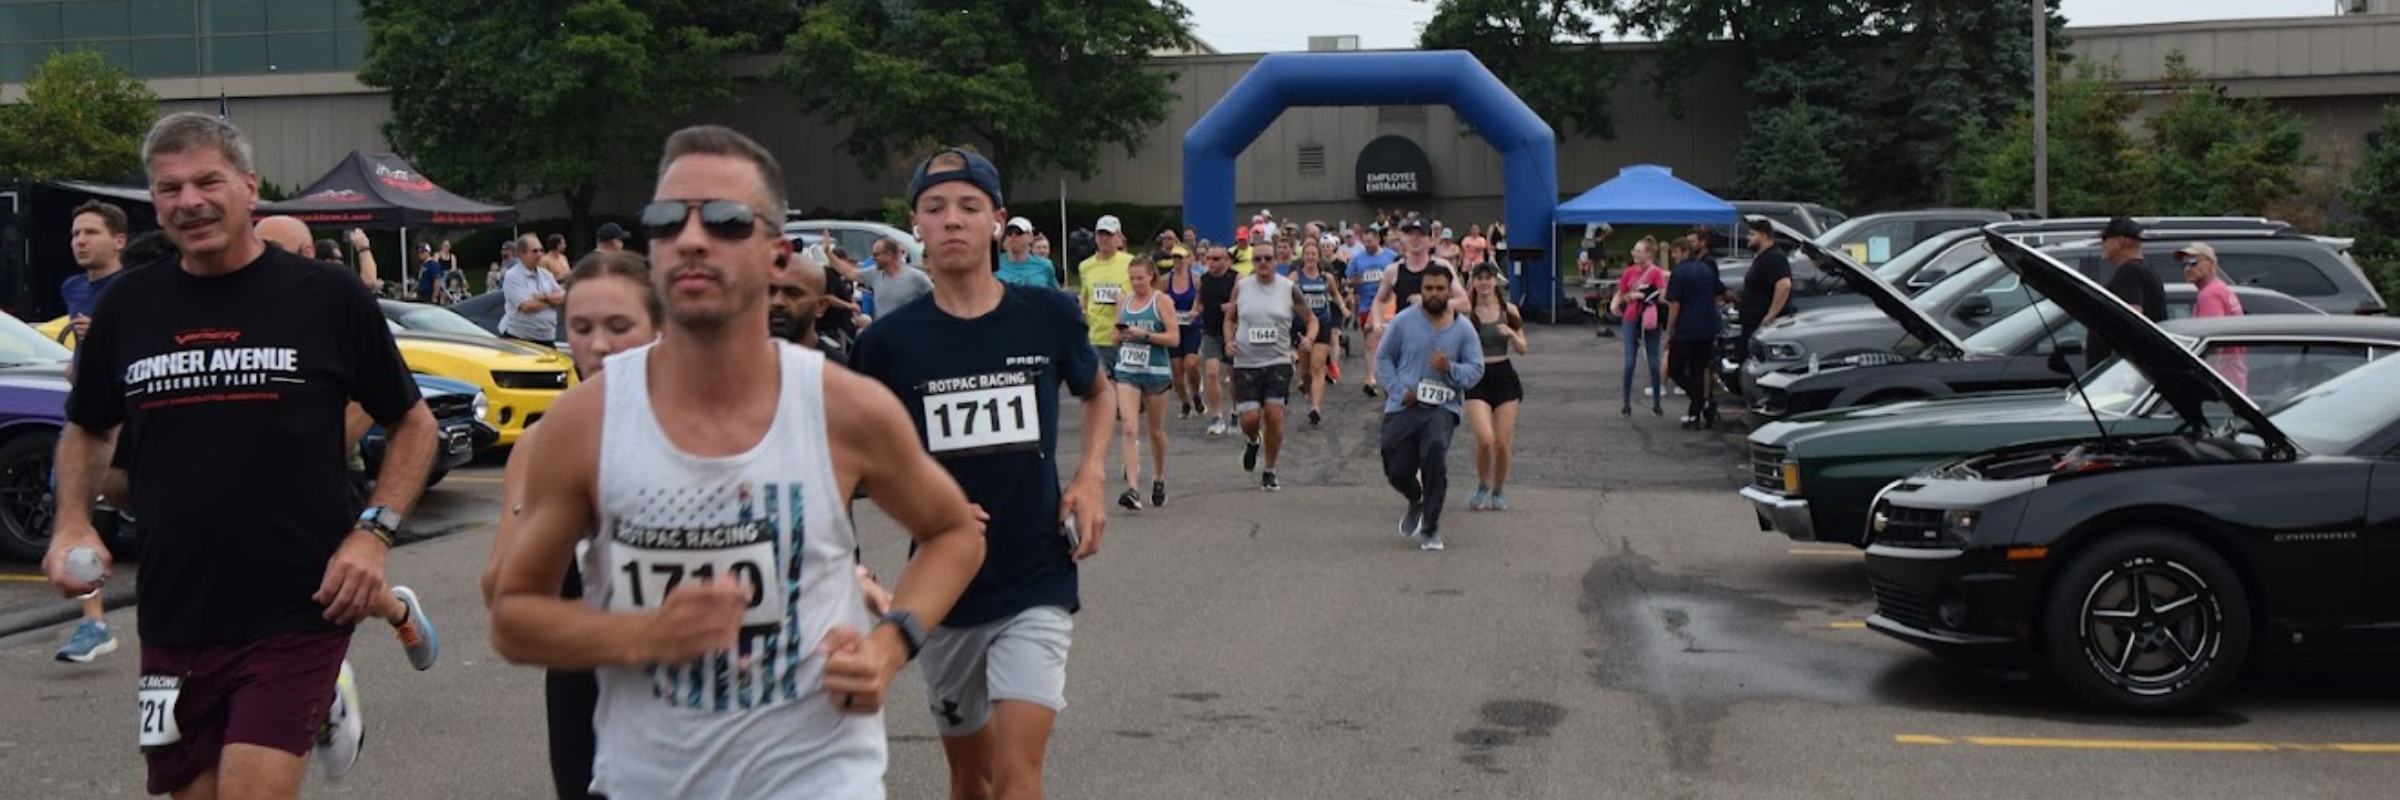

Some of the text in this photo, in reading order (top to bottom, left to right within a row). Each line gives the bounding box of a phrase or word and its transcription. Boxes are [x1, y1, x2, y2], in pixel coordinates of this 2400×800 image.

[1366, 182, 1417, 192] ENTRANCE
[1367, 172, 1416, 181] EMPLOYEE
[1251, 330, 1276, 340] 1644
[125, 348, 298, 384] CONNER AVENUE
[147, 373, 266, 393] ASSEMBLY PLANT
[928, 371, 1026, 393] ROTPAC RACING
[934, 395, 1025, 438] 1711
[619, 522, 760, 547] ROTPAC RACING
[2274, 532, 2357, 541] CAMARO
[140, 699, 166, 733] 21
